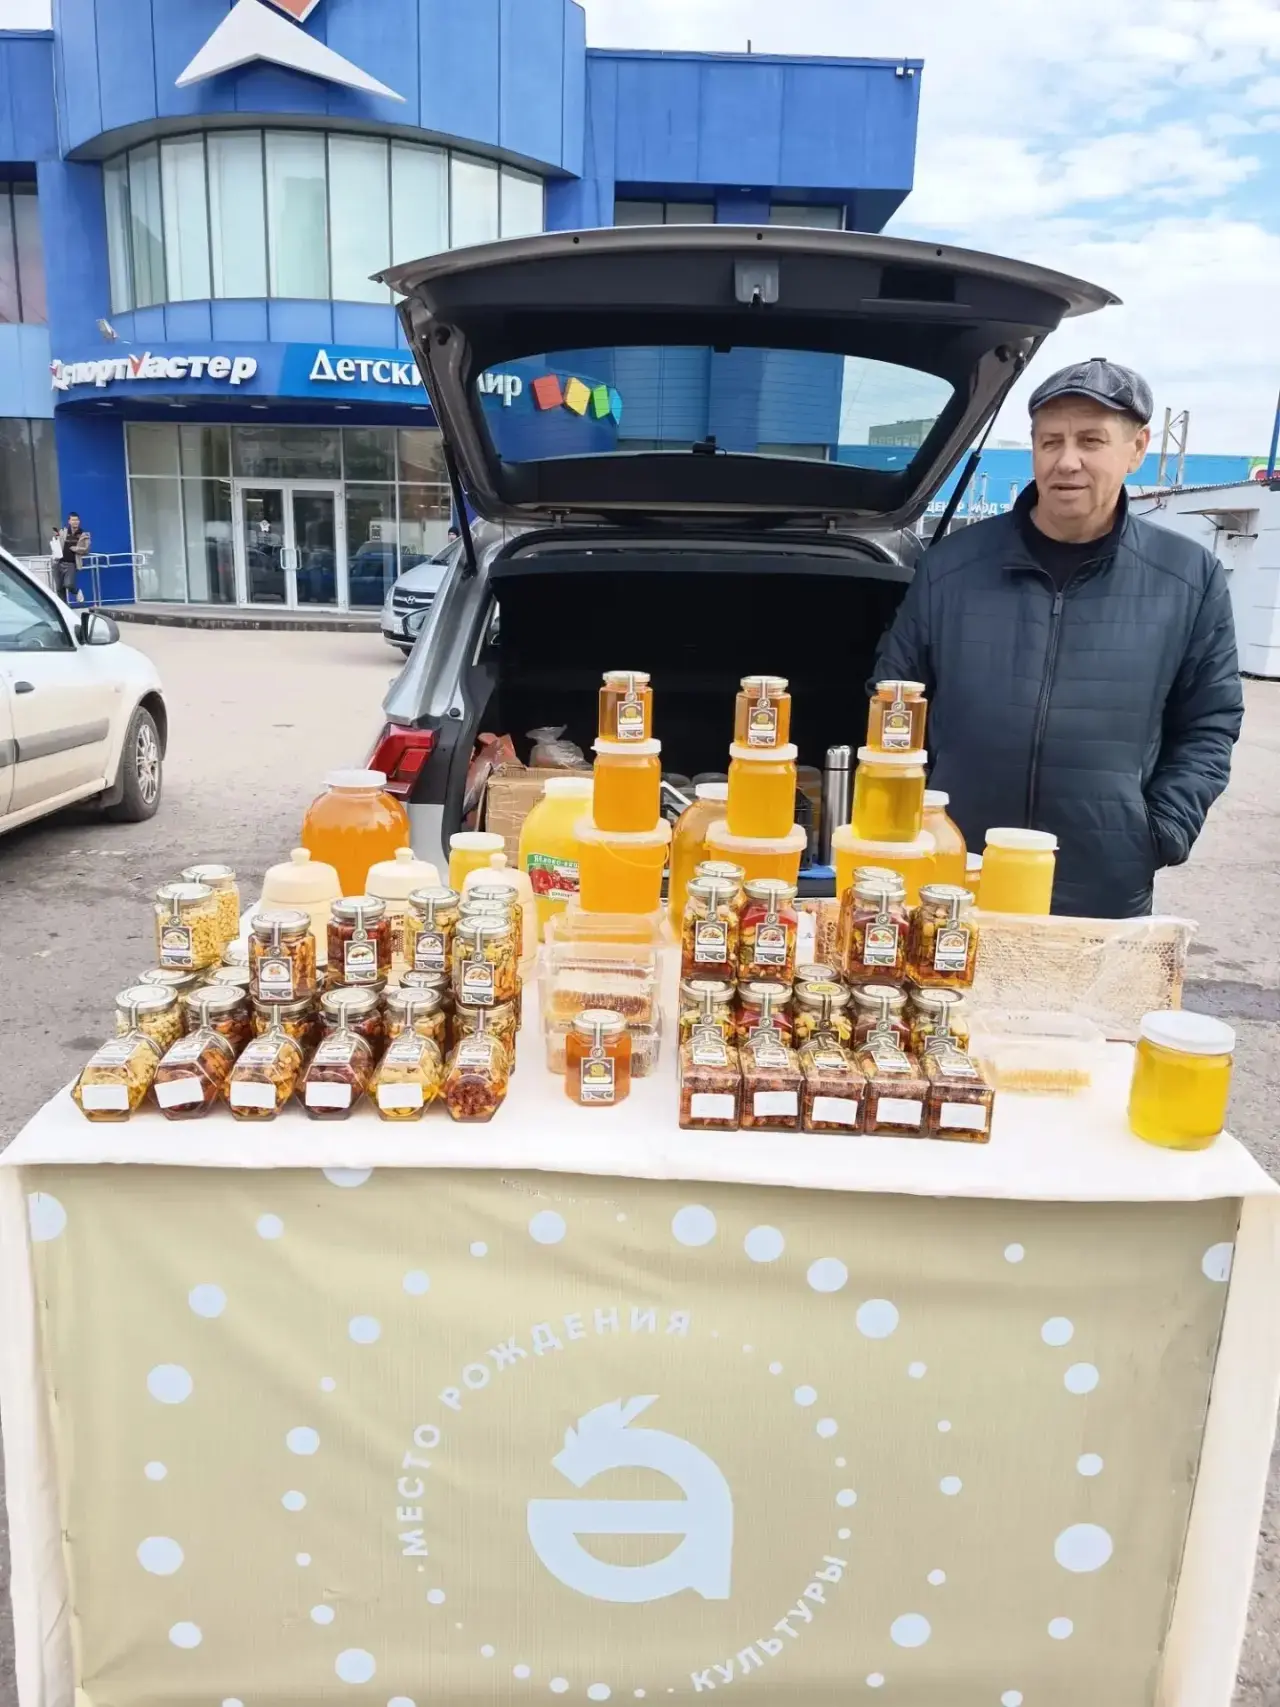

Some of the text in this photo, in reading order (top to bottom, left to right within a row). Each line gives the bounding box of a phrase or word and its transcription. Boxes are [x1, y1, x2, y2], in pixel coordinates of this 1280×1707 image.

[309, 349, 422, 386] Детски
[396, 1306, 691, 1556] МЕСТО РОЖДЕНИЯ
[690, 1555, 848, 1693] КУЛЬТУРЫ
